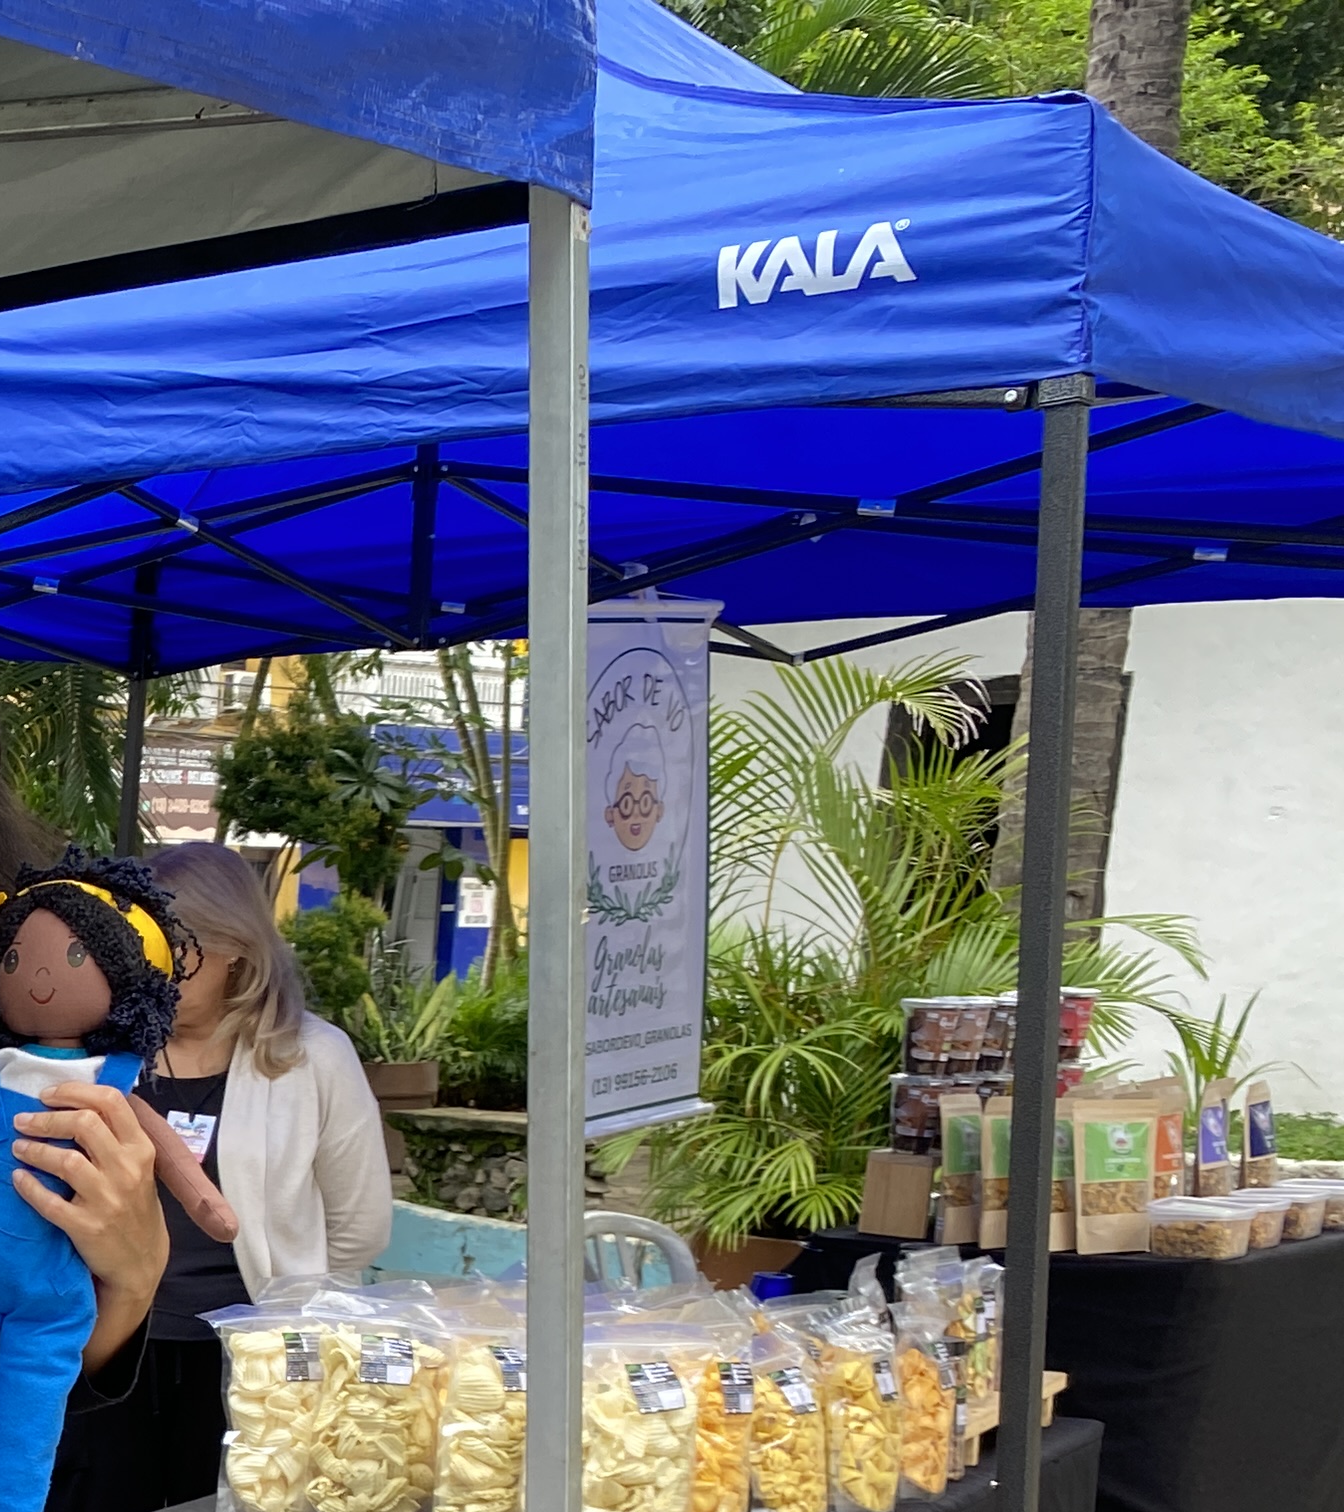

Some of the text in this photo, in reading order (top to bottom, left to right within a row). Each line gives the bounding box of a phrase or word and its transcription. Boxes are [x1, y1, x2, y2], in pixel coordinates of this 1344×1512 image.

[717, 221, 918, 310] KALA
[643, 673, 664, 706] DE
[608, 861, 658, 883] GRANOLAS
[591, 925, 666, 993] Granolas
